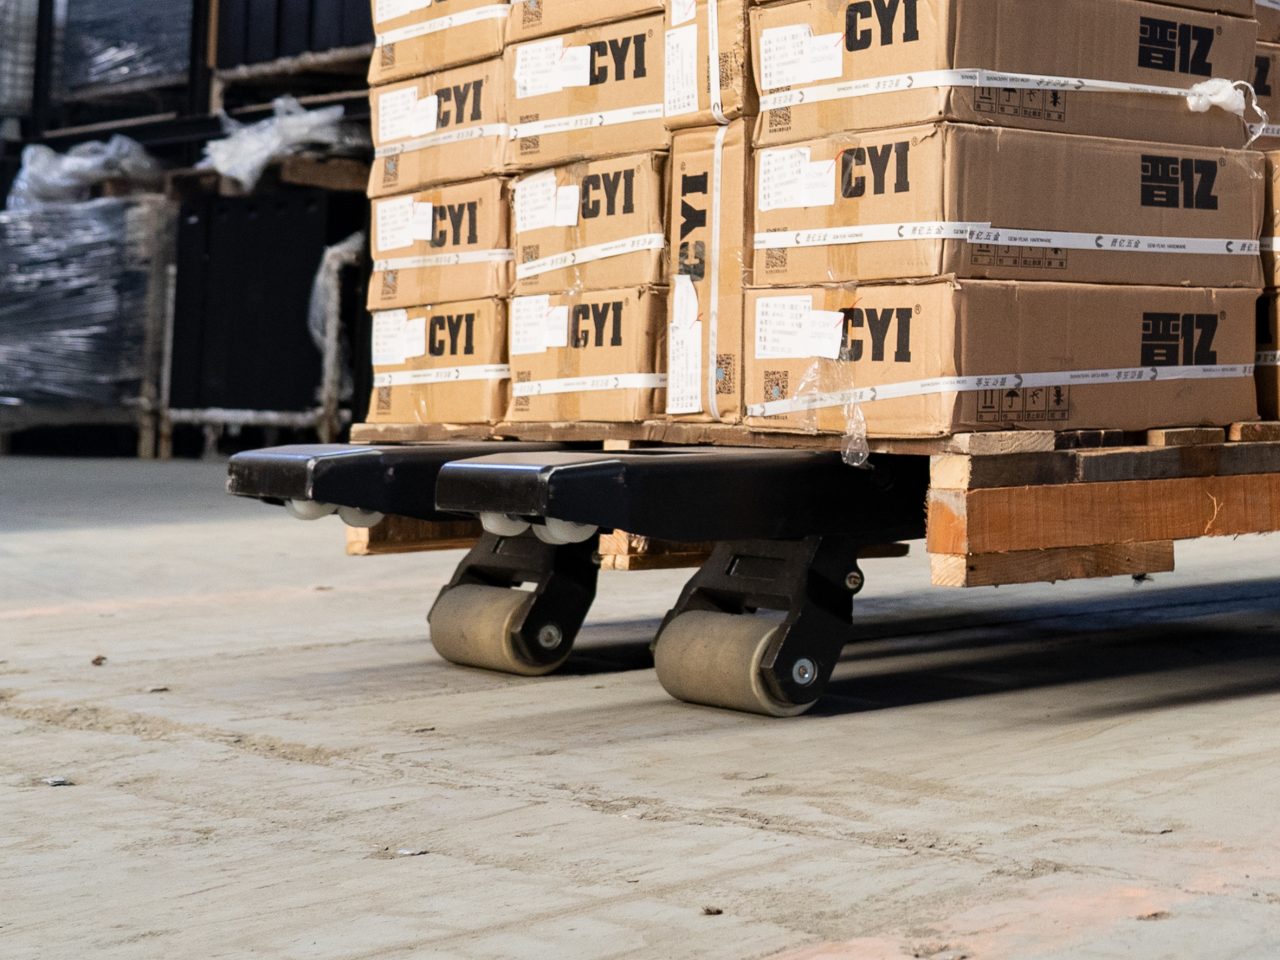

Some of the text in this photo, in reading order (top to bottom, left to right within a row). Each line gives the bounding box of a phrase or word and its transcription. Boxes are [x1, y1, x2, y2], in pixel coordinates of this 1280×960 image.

[588, 34, 646, 86] CYI
[1138, 17, 1214, 76] 晋亿
[435, 80, 483, 128] CYI
[581, 169, 634, 219] CYI
[841, 141, 909, 198] CYI
[1141, 155, 1218, 210] 晋亿
[430, 202, 477, 248] CYI
[678, 172, 708, 282] CYI
[429, 314, 474, 356] CYI
[571, 302, 622, 348] CYI
[839, 307, 912, 362] CYI
[1141, 313, 1217, 366] 晋亿
